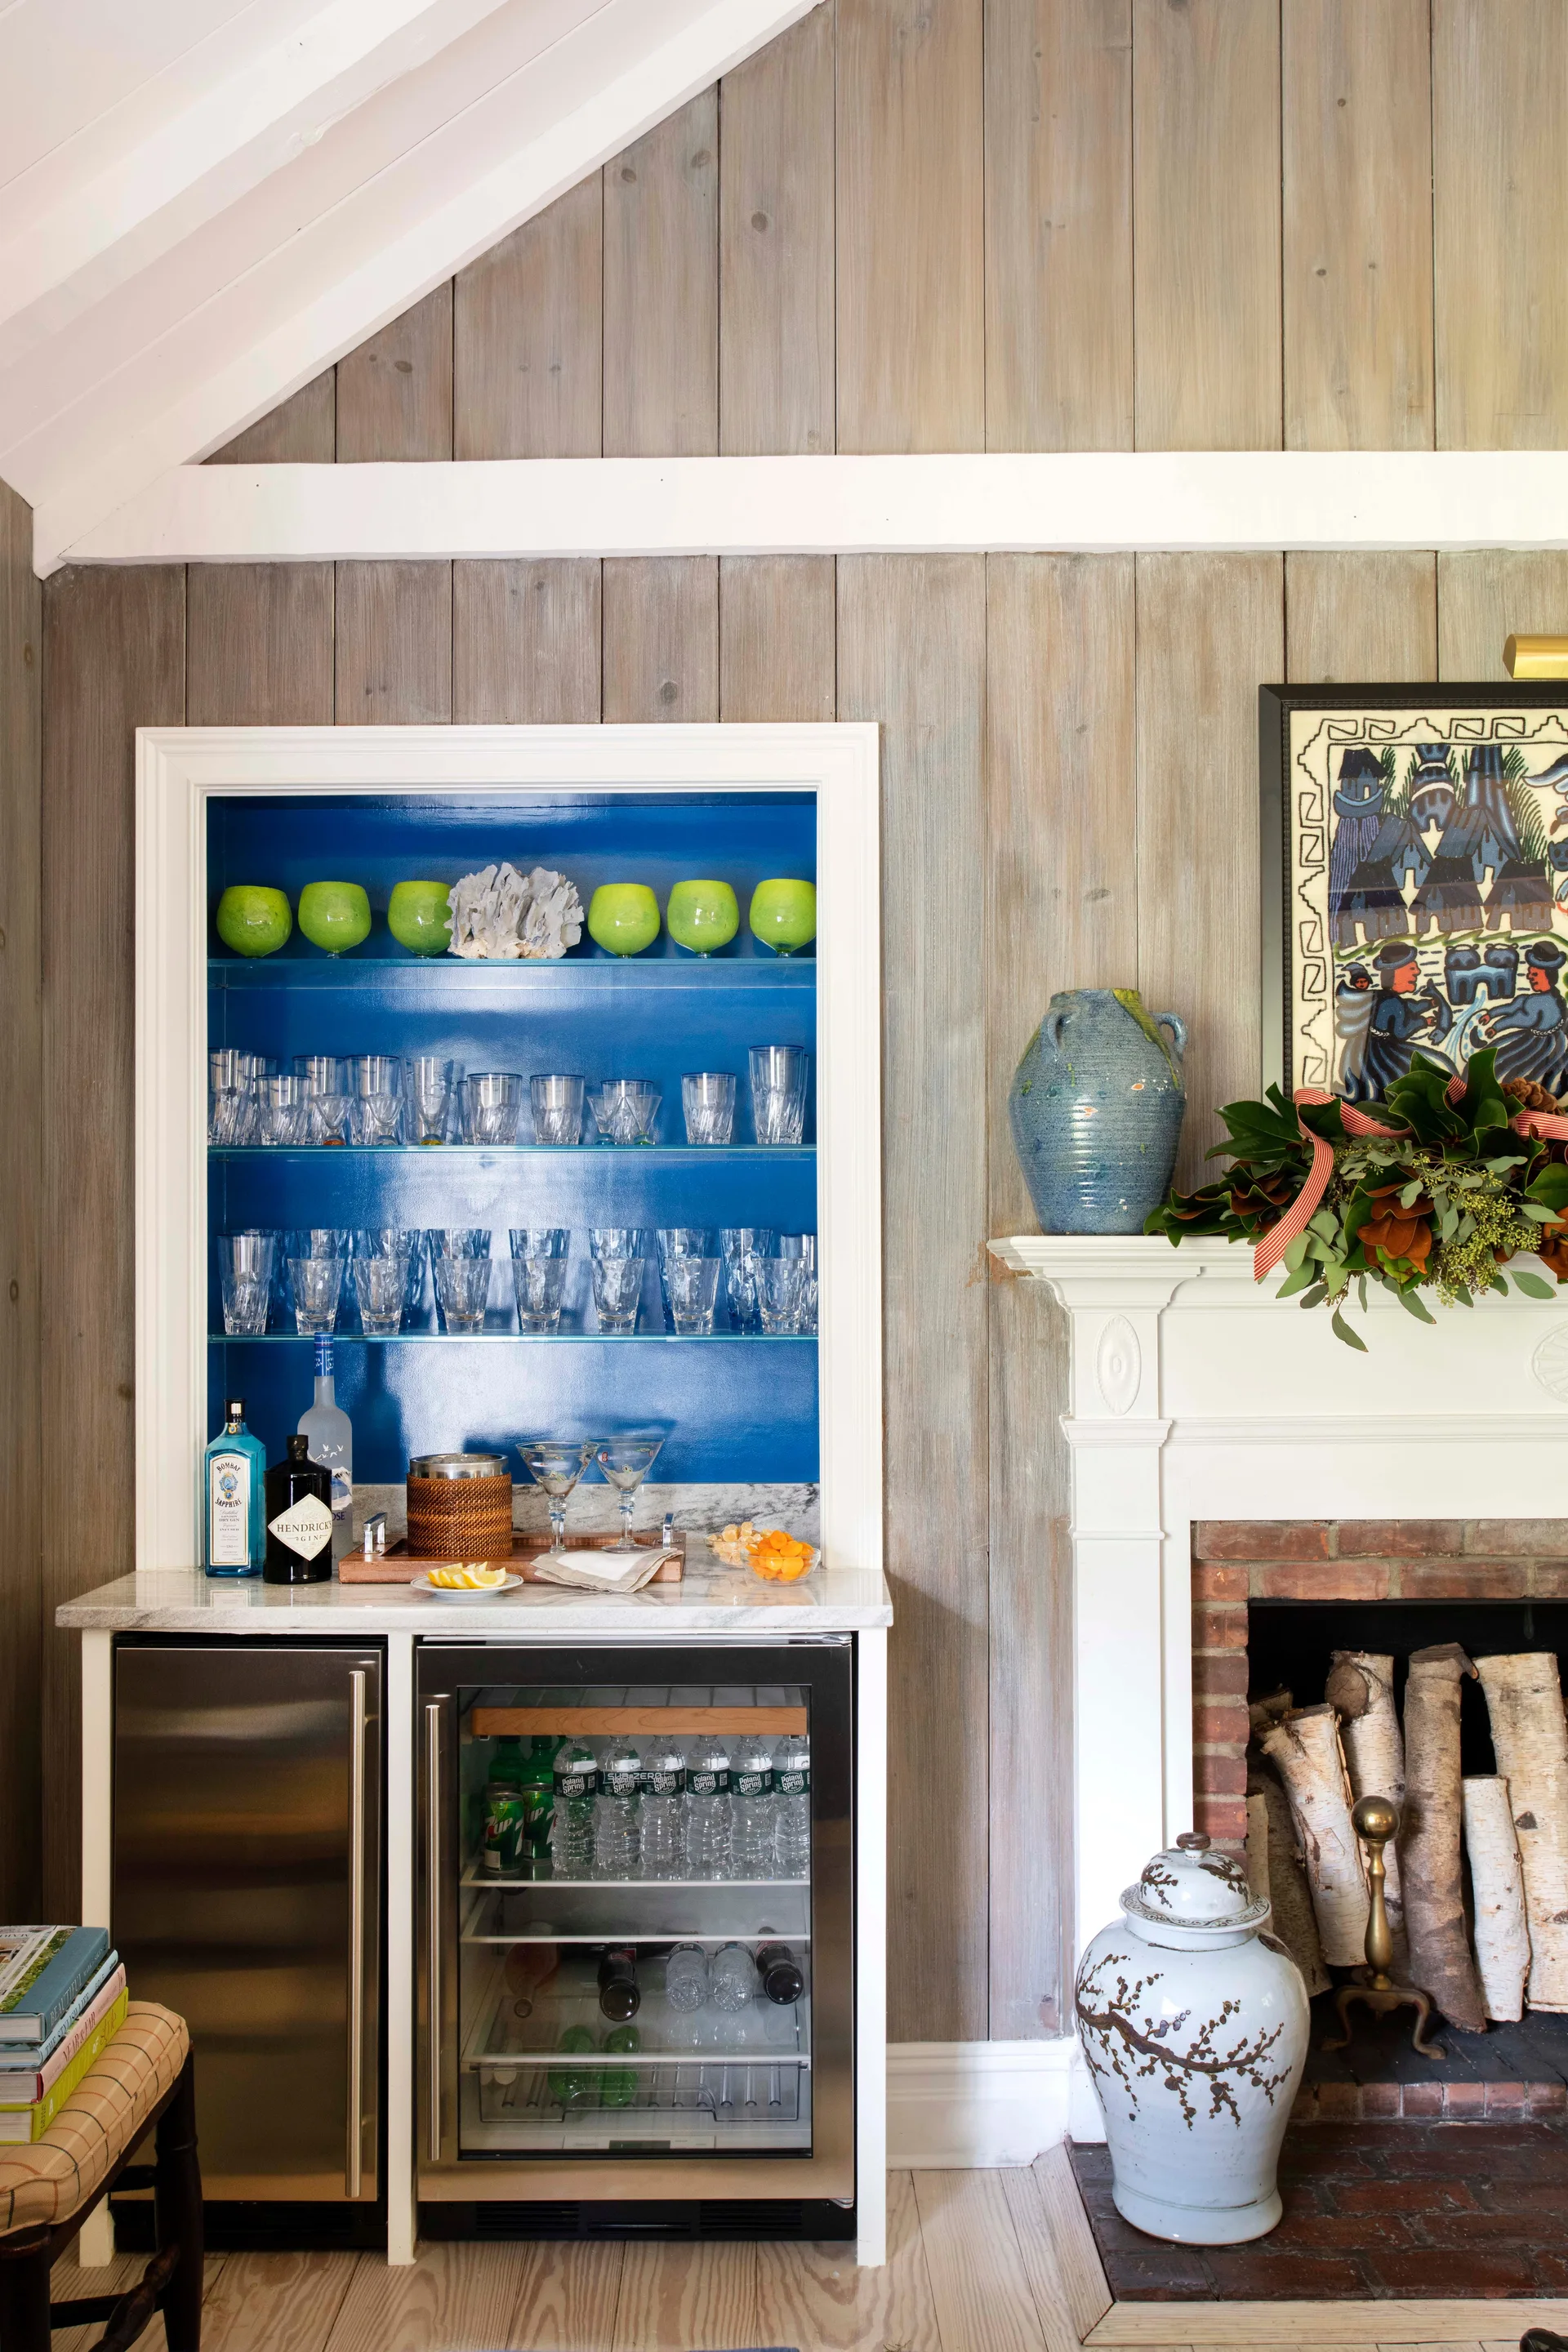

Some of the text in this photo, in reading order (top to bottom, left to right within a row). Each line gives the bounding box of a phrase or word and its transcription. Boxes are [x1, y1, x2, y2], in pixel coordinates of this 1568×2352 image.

[216, 1462, 241, 1473] BOMBAY
[215, 1497, 242, 1508] SAPPHIRE
[277, 1520, 332, 1532] HENDRICK'S
[562, 1776, 584, 1786] Poland
[693, 1773, 715, 1784] Poland
[739, 1773, 761, 1785] Poland
[781, 1772, 803, 1784] Poland
[563, 1783, 585, 1794] Spring
[613, 1782, 635, 1793] Spring
[654, 1780, 676, 1792] Spring
[694, 1780, 716, 1791] Spring
[740, 1781, 762, 1793] Spring
[782, 1779, 804, 1791] Spring
[50, 1973, 82, 2026] BEAUTIFUL
[45, 2036, 56, 2054] THE
[57, 2007, 78, 2038] STYLISH
[78, 1992, 89, 2013] LIFE
[85, 2011, 96, 2034] FAR
